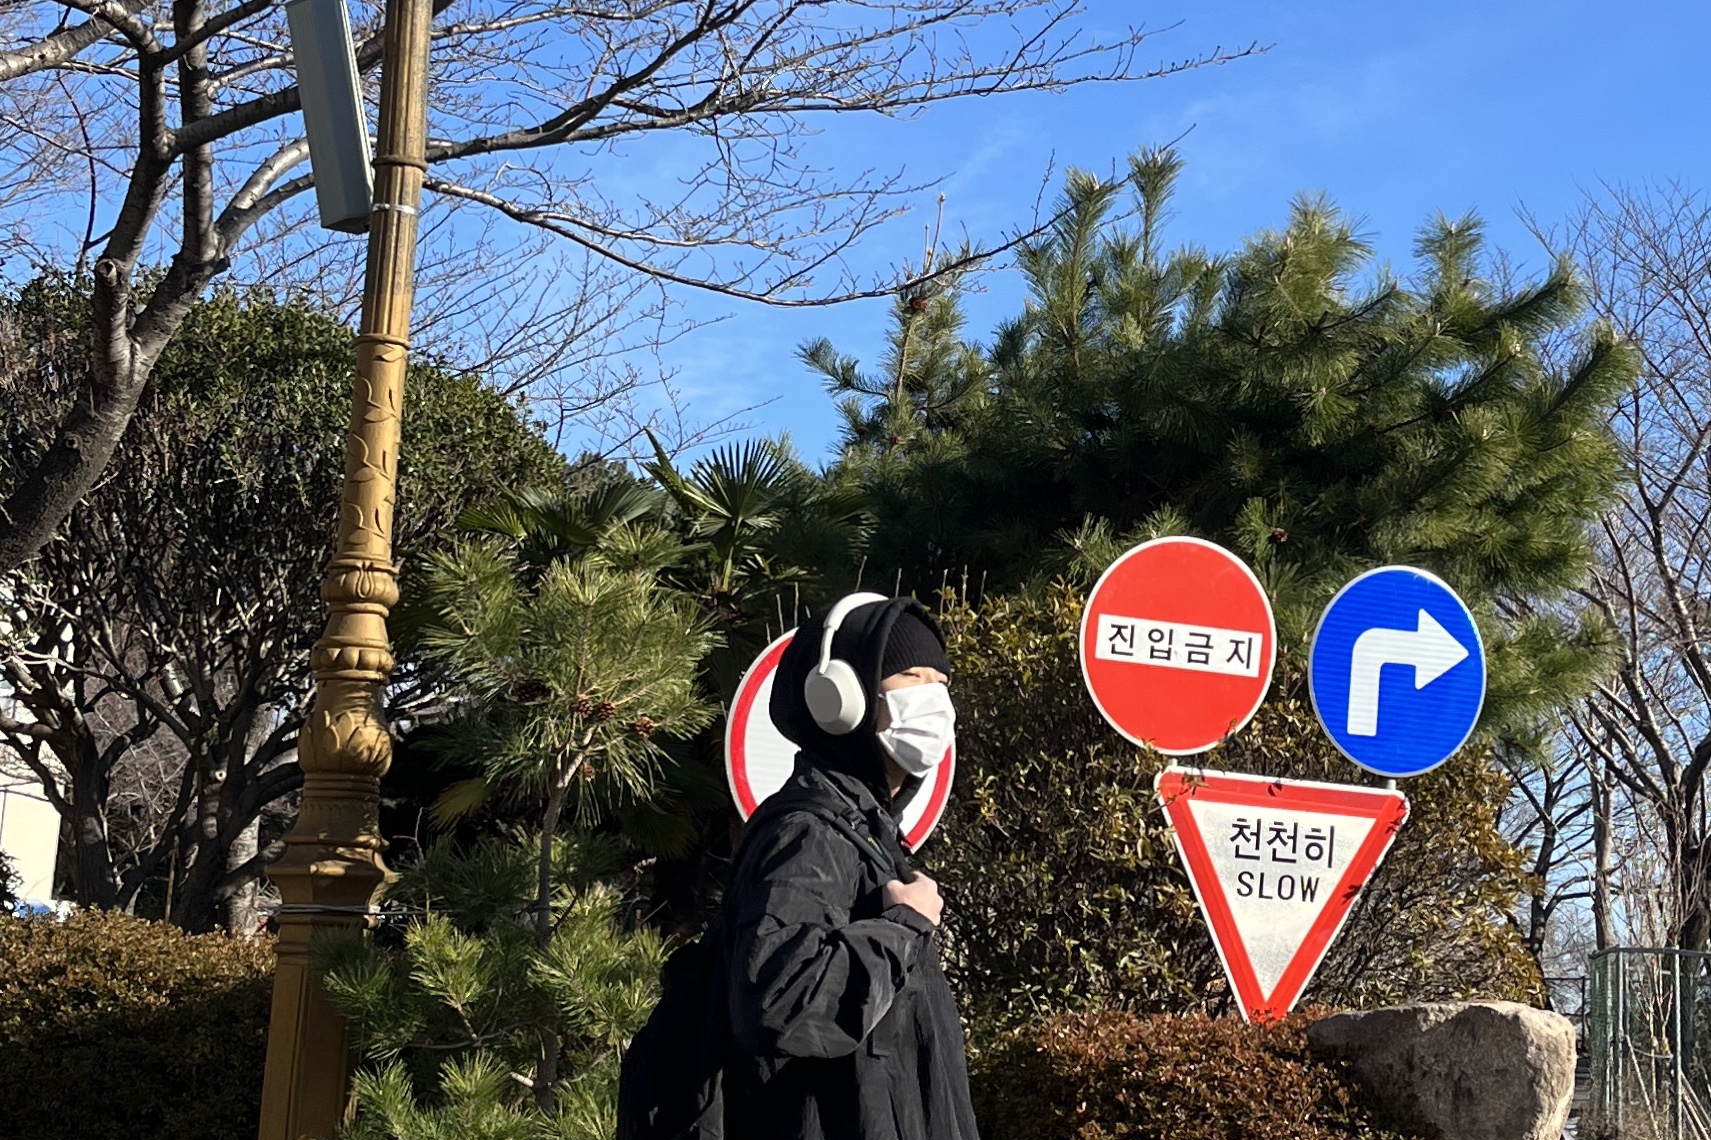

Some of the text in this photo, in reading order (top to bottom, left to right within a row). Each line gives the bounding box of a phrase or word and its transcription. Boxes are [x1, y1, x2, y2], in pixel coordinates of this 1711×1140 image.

[1108, 623, 1253, 669] 진입금지
[1229, 818, 1335, 868] 천천히
[1236, 872, 1320, 903] SLOW
